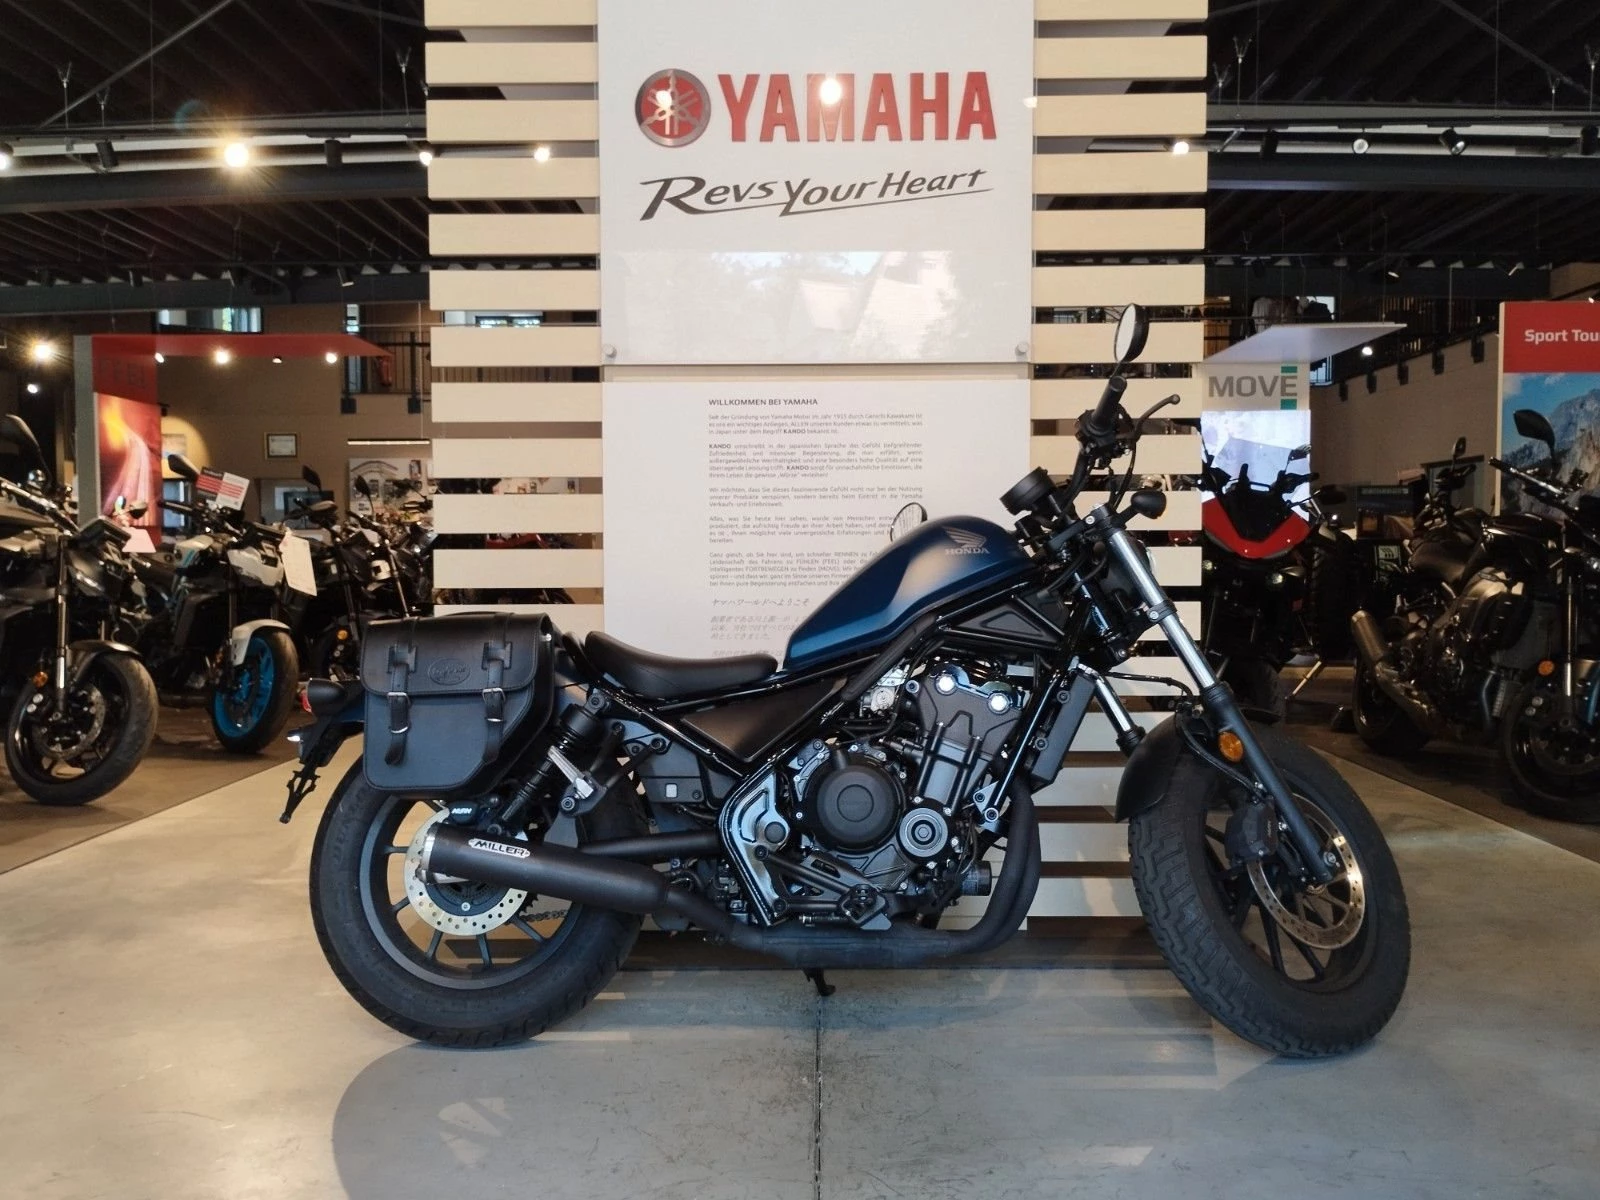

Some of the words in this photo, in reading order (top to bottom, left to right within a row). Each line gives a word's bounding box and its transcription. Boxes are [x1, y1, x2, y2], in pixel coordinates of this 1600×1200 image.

[717, 71, 997, 142] YAMAHA
[639, 175, 778, 221] Revs
[779, 177, 879, 217] Your
[877, 168, 987, 199] Heart
[1524, 329, 1568, 345] Sport
[1571, 329, 1600, 342] Tou
[1208, 375, 1298, 397] MOVE
[945, 547, 990, 555] HONDA
[475, 840, 525, 856] MILLER
